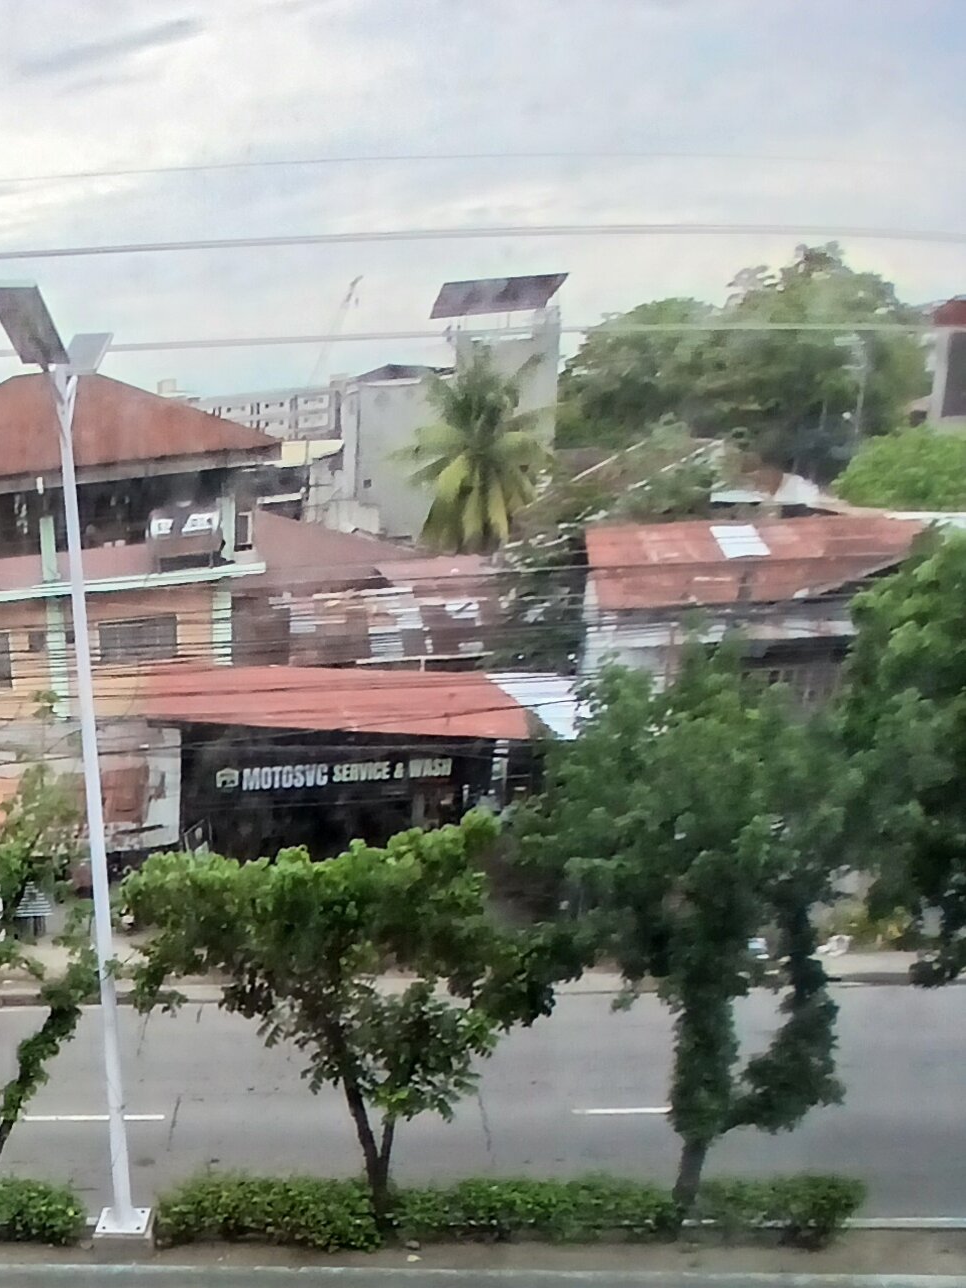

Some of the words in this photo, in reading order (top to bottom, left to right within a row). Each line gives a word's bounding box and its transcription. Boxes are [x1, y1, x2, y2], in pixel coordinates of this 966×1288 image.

[242, 764, 328, 791] MOTOSVC
[333, 761, 390, 782] SERVICE
[393, 762, 404, 778] &
[409, 758, 453, 777] WASH
